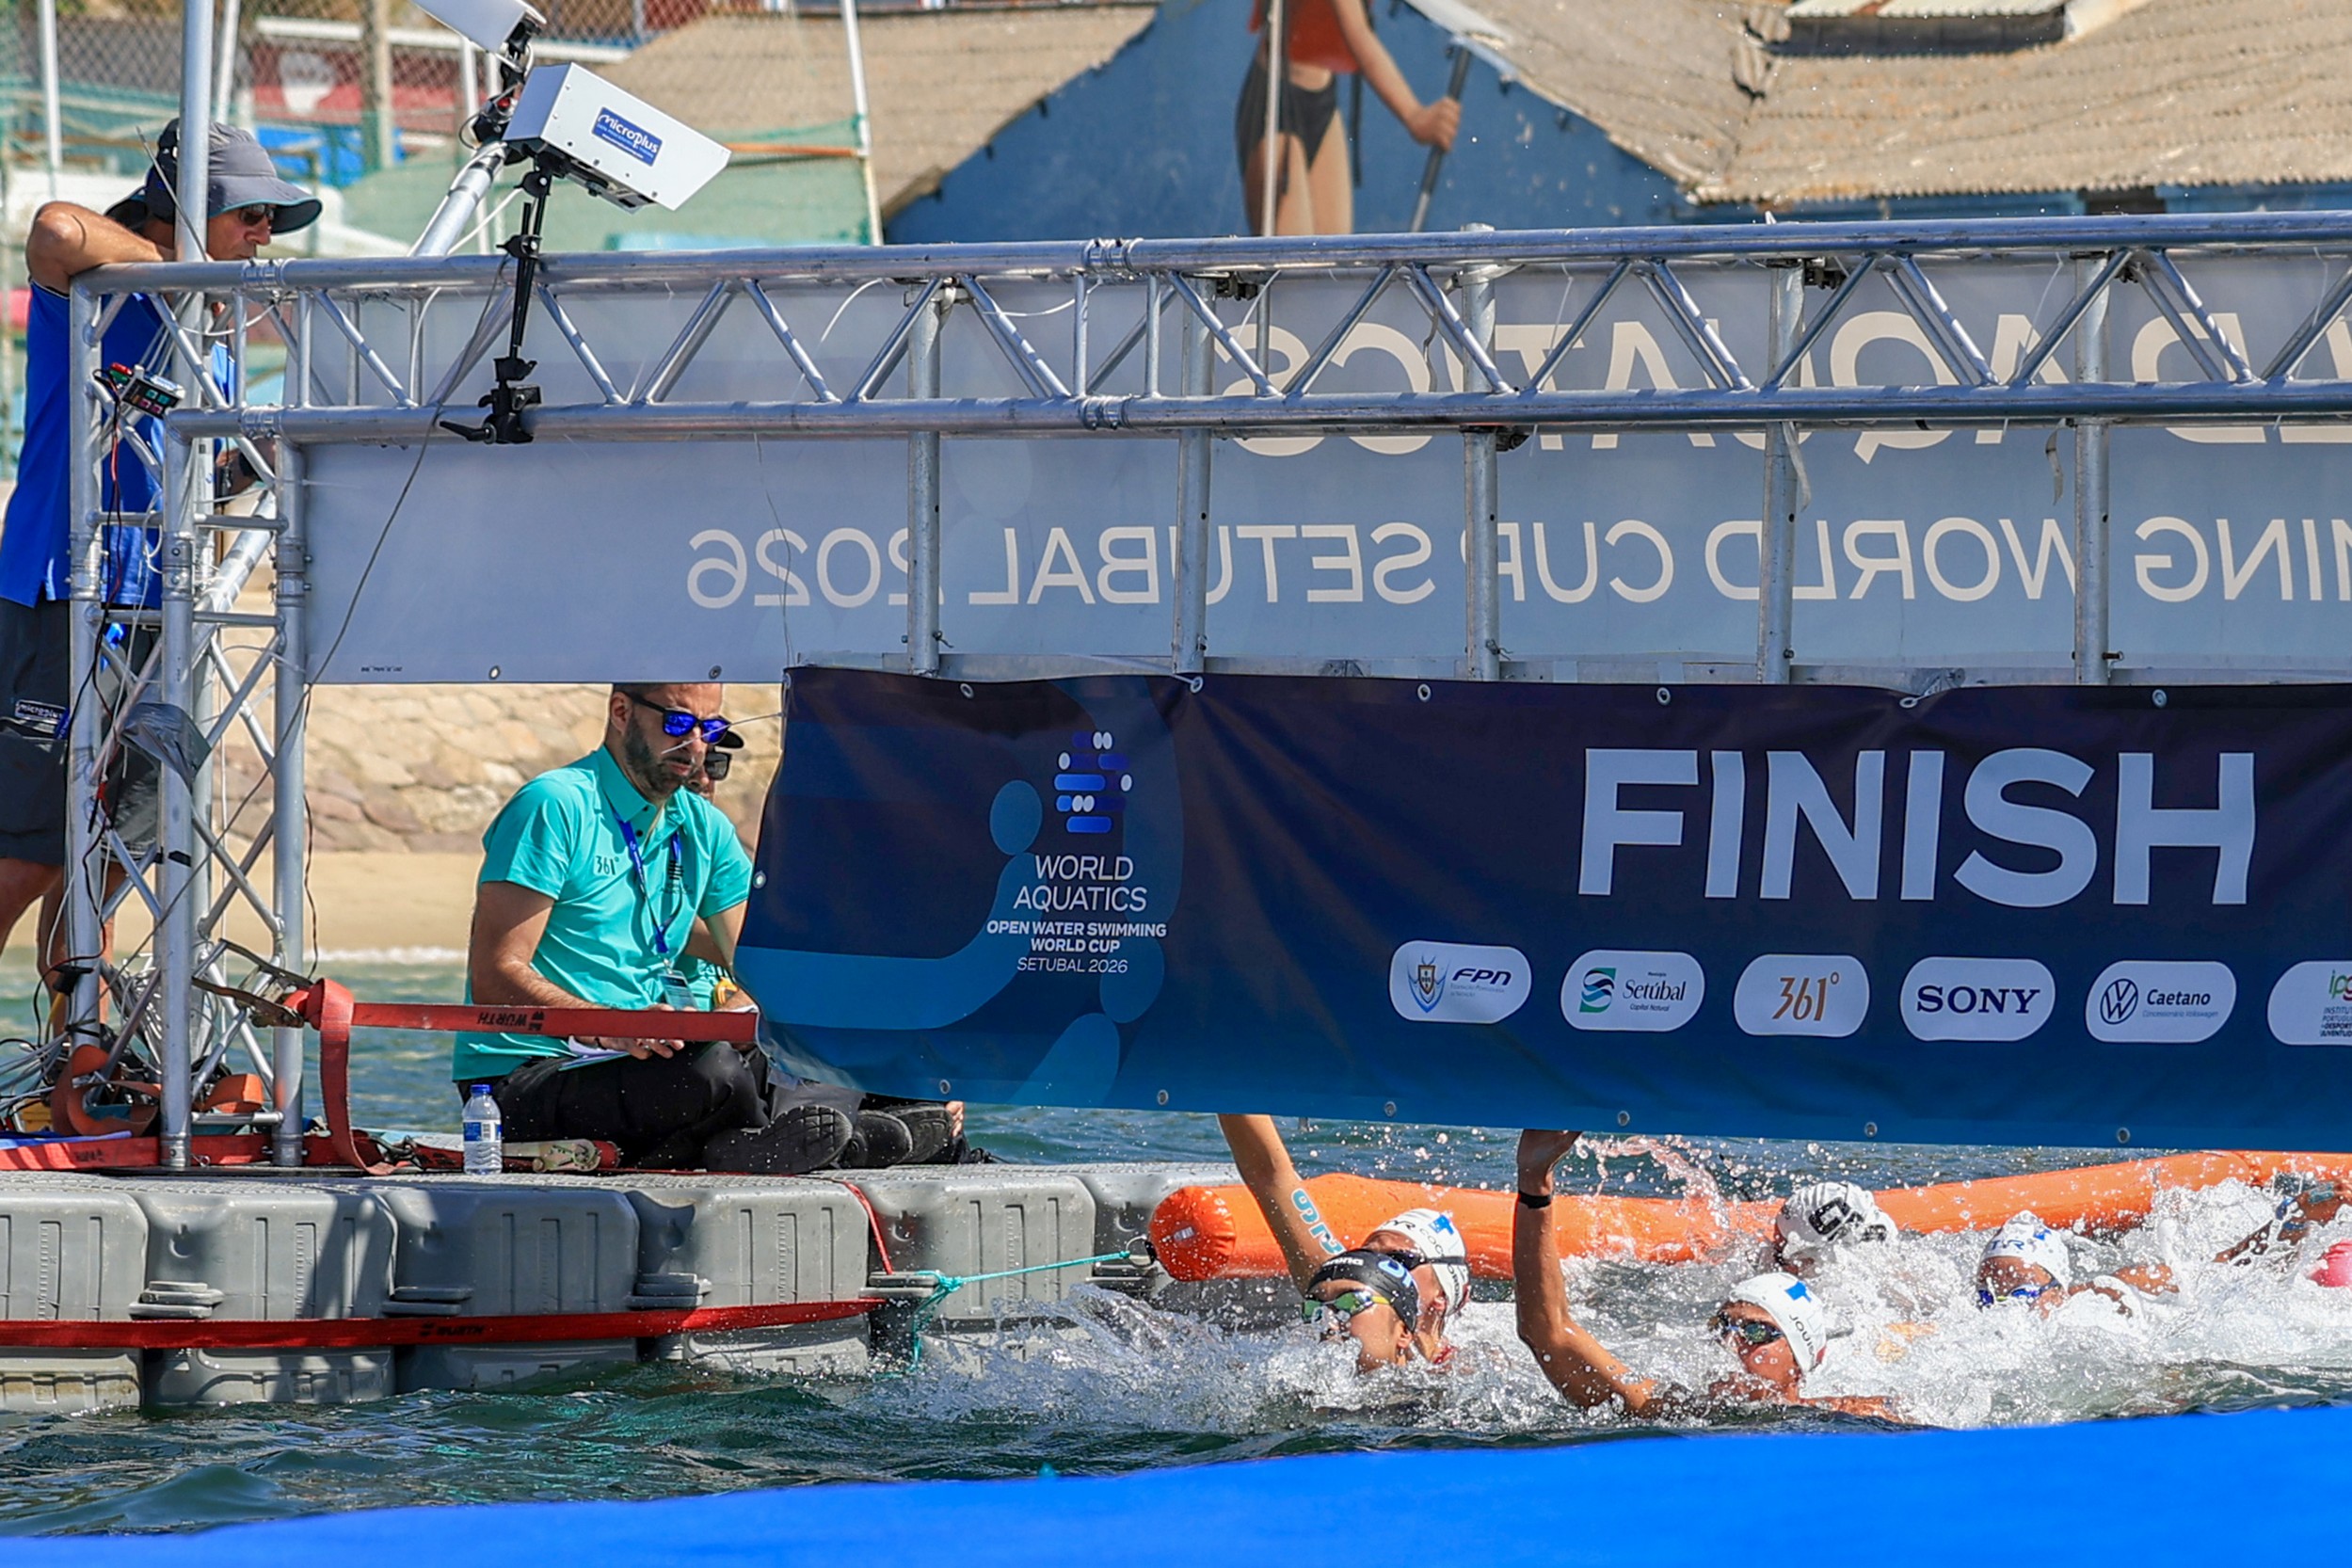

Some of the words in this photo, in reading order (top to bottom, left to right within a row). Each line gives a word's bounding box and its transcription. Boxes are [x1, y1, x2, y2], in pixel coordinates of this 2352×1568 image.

[1578, 747, 2255, 908] FINISH
[1035, 855, 1134, 881] WORLD
[1013, 885, 1148, 913] AQUATICS
[987, 920, 1031, 935] OPEN
[1032, 921, 1085, 936] WATER
[1086, 922, 1167, 937] SWIMMING
[1031, 938, 1086, 952] WORLD
[1088, 939, 1121, 953] CUP
[1016, 956, 1086, 972] SETUBAL
[1088, 958, 1128, 973] 2026
[1622, 979, 1687, 1000] Setúbal
[1771, 971, 1840, 1021] 361°
[1917, 984, 2040, 1014] SONY
[2147, 988, 2211, 1006] Caetano
